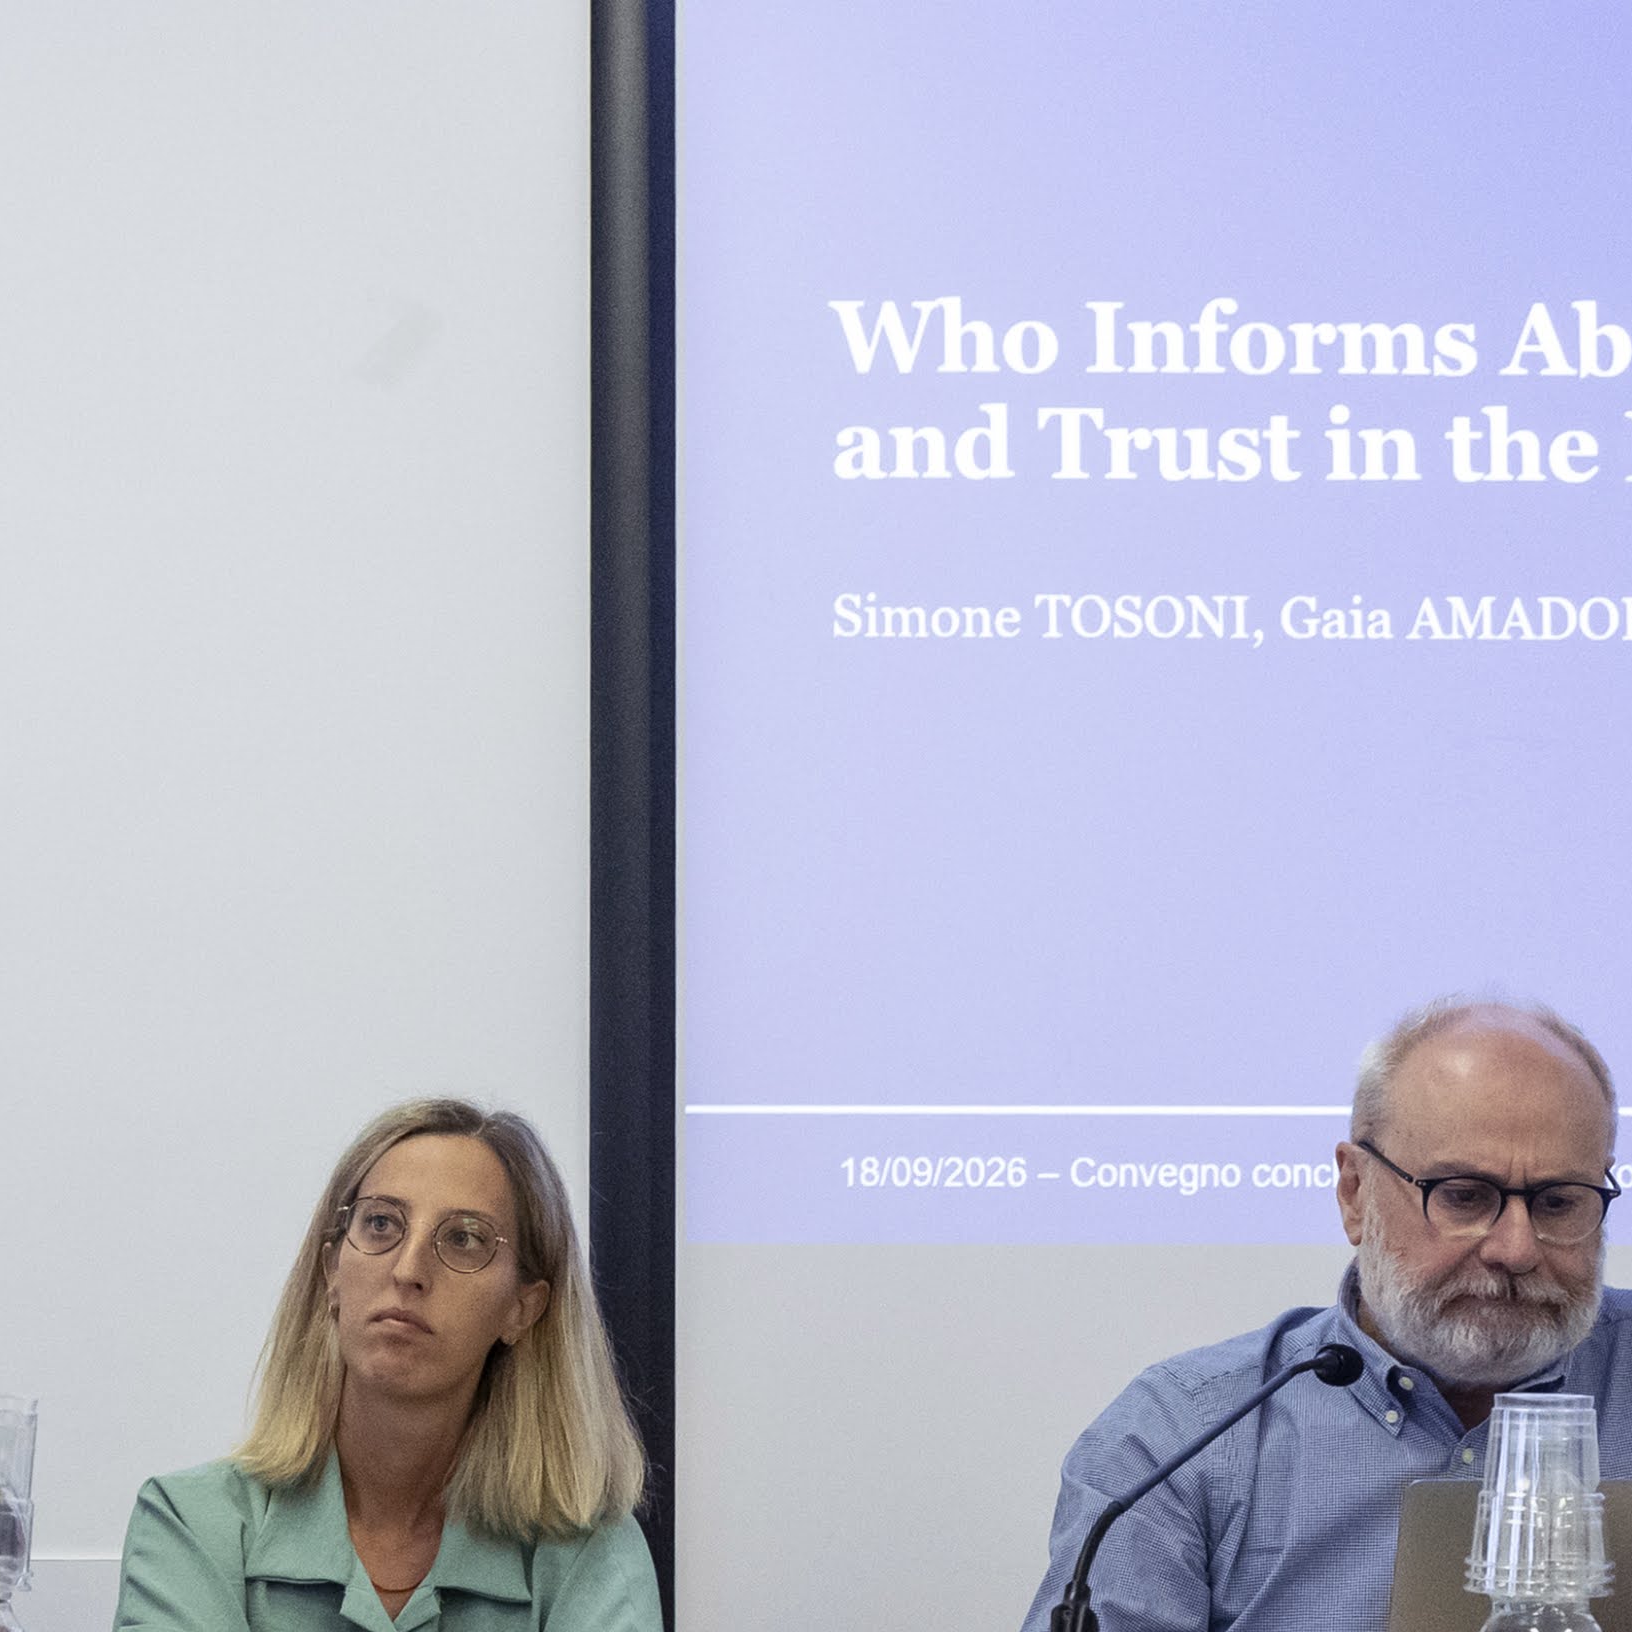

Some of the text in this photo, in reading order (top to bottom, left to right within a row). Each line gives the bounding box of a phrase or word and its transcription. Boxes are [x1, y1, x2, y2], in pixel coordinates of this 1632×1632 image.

[830, 297, 1060, 376] Who
[1086, 298, 1479, 379] Informs
[833, 403, 1017, 482] and
[1038, 407, 1303, 483] Trust
[1325, 405, 1423, 482] in
[1445, 406, 1600, 485] the
[833, 592, 1022, 640] Simone
[1035, 594, 1266, 648] TOSONI,
[1281, 595, 1395, 640] Gaia
[840, 1157, 1029, 1189] 18/09/2026
[1070, 1158, 1242, 1197] Convegno
[1252, 1158, 1340, 1189] concl
